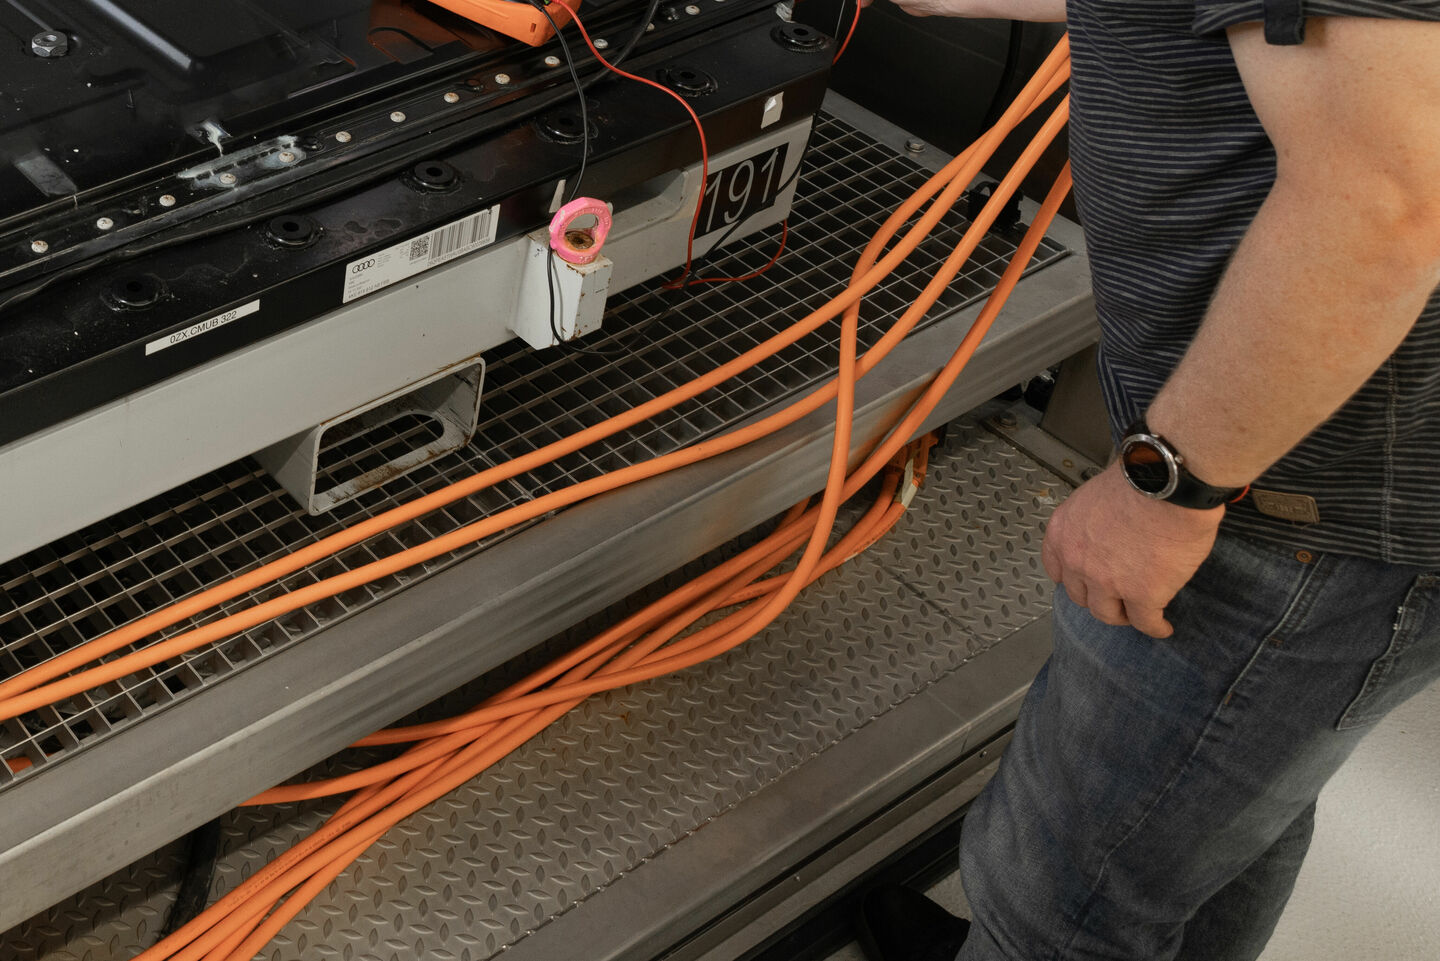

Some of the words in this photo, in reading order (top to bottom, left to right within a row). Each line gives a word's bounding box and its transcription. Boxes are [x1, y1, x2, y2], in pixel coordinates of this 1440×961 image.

[705, 148, 779, 233] 191
[169, 318, 219, 344] 0ZX.CMUB
[220, 310, 237, 323] 322
